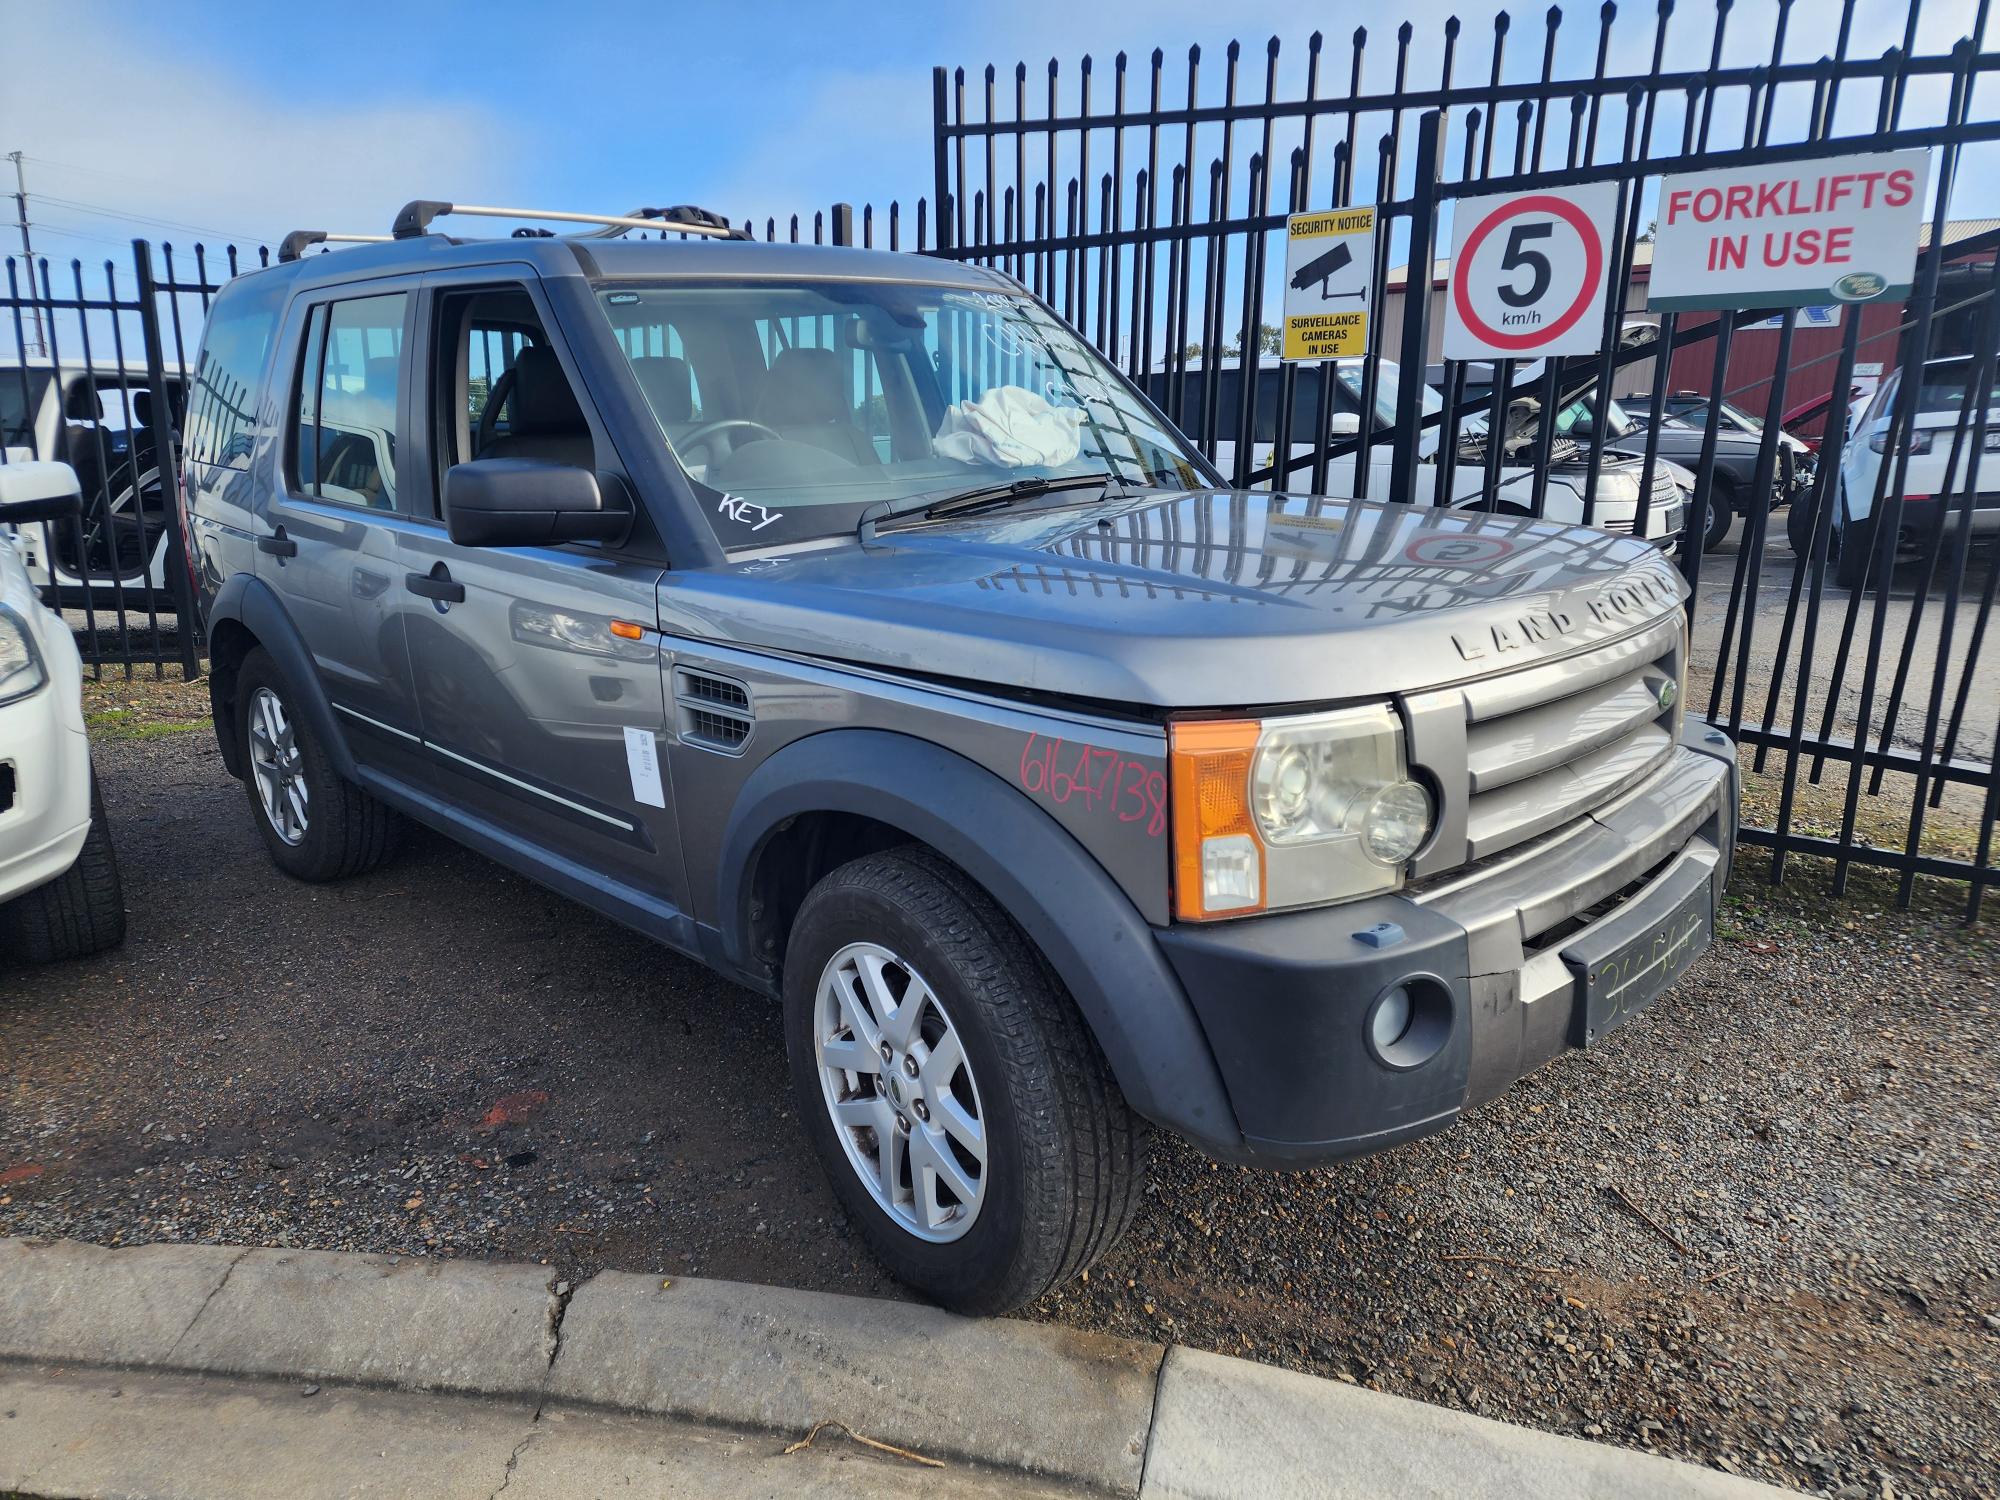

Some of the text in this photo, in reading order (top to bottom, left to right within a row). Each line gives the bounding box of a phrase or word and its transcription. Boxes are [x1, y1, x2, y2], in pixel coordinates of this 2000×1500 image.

[1667, 169, 1915, 225] FORKLIFTS
[1290, 214, 1372, 235] SECURITY NOTICE
[1707, 227, 1854, 271] IN USE
[1497, 221, 1553, 307] 5
[1291, 314, 1360, 329] SURVEILLANCE
[1502, 310, 1541, 326] km/h
[1301, 330, 1348, 342] CAMERAS
[1308, 343, 1339, 355] IN USE
[718, 493, 783, 531] KEY
[1450, 610, 1577, 661] LAND
